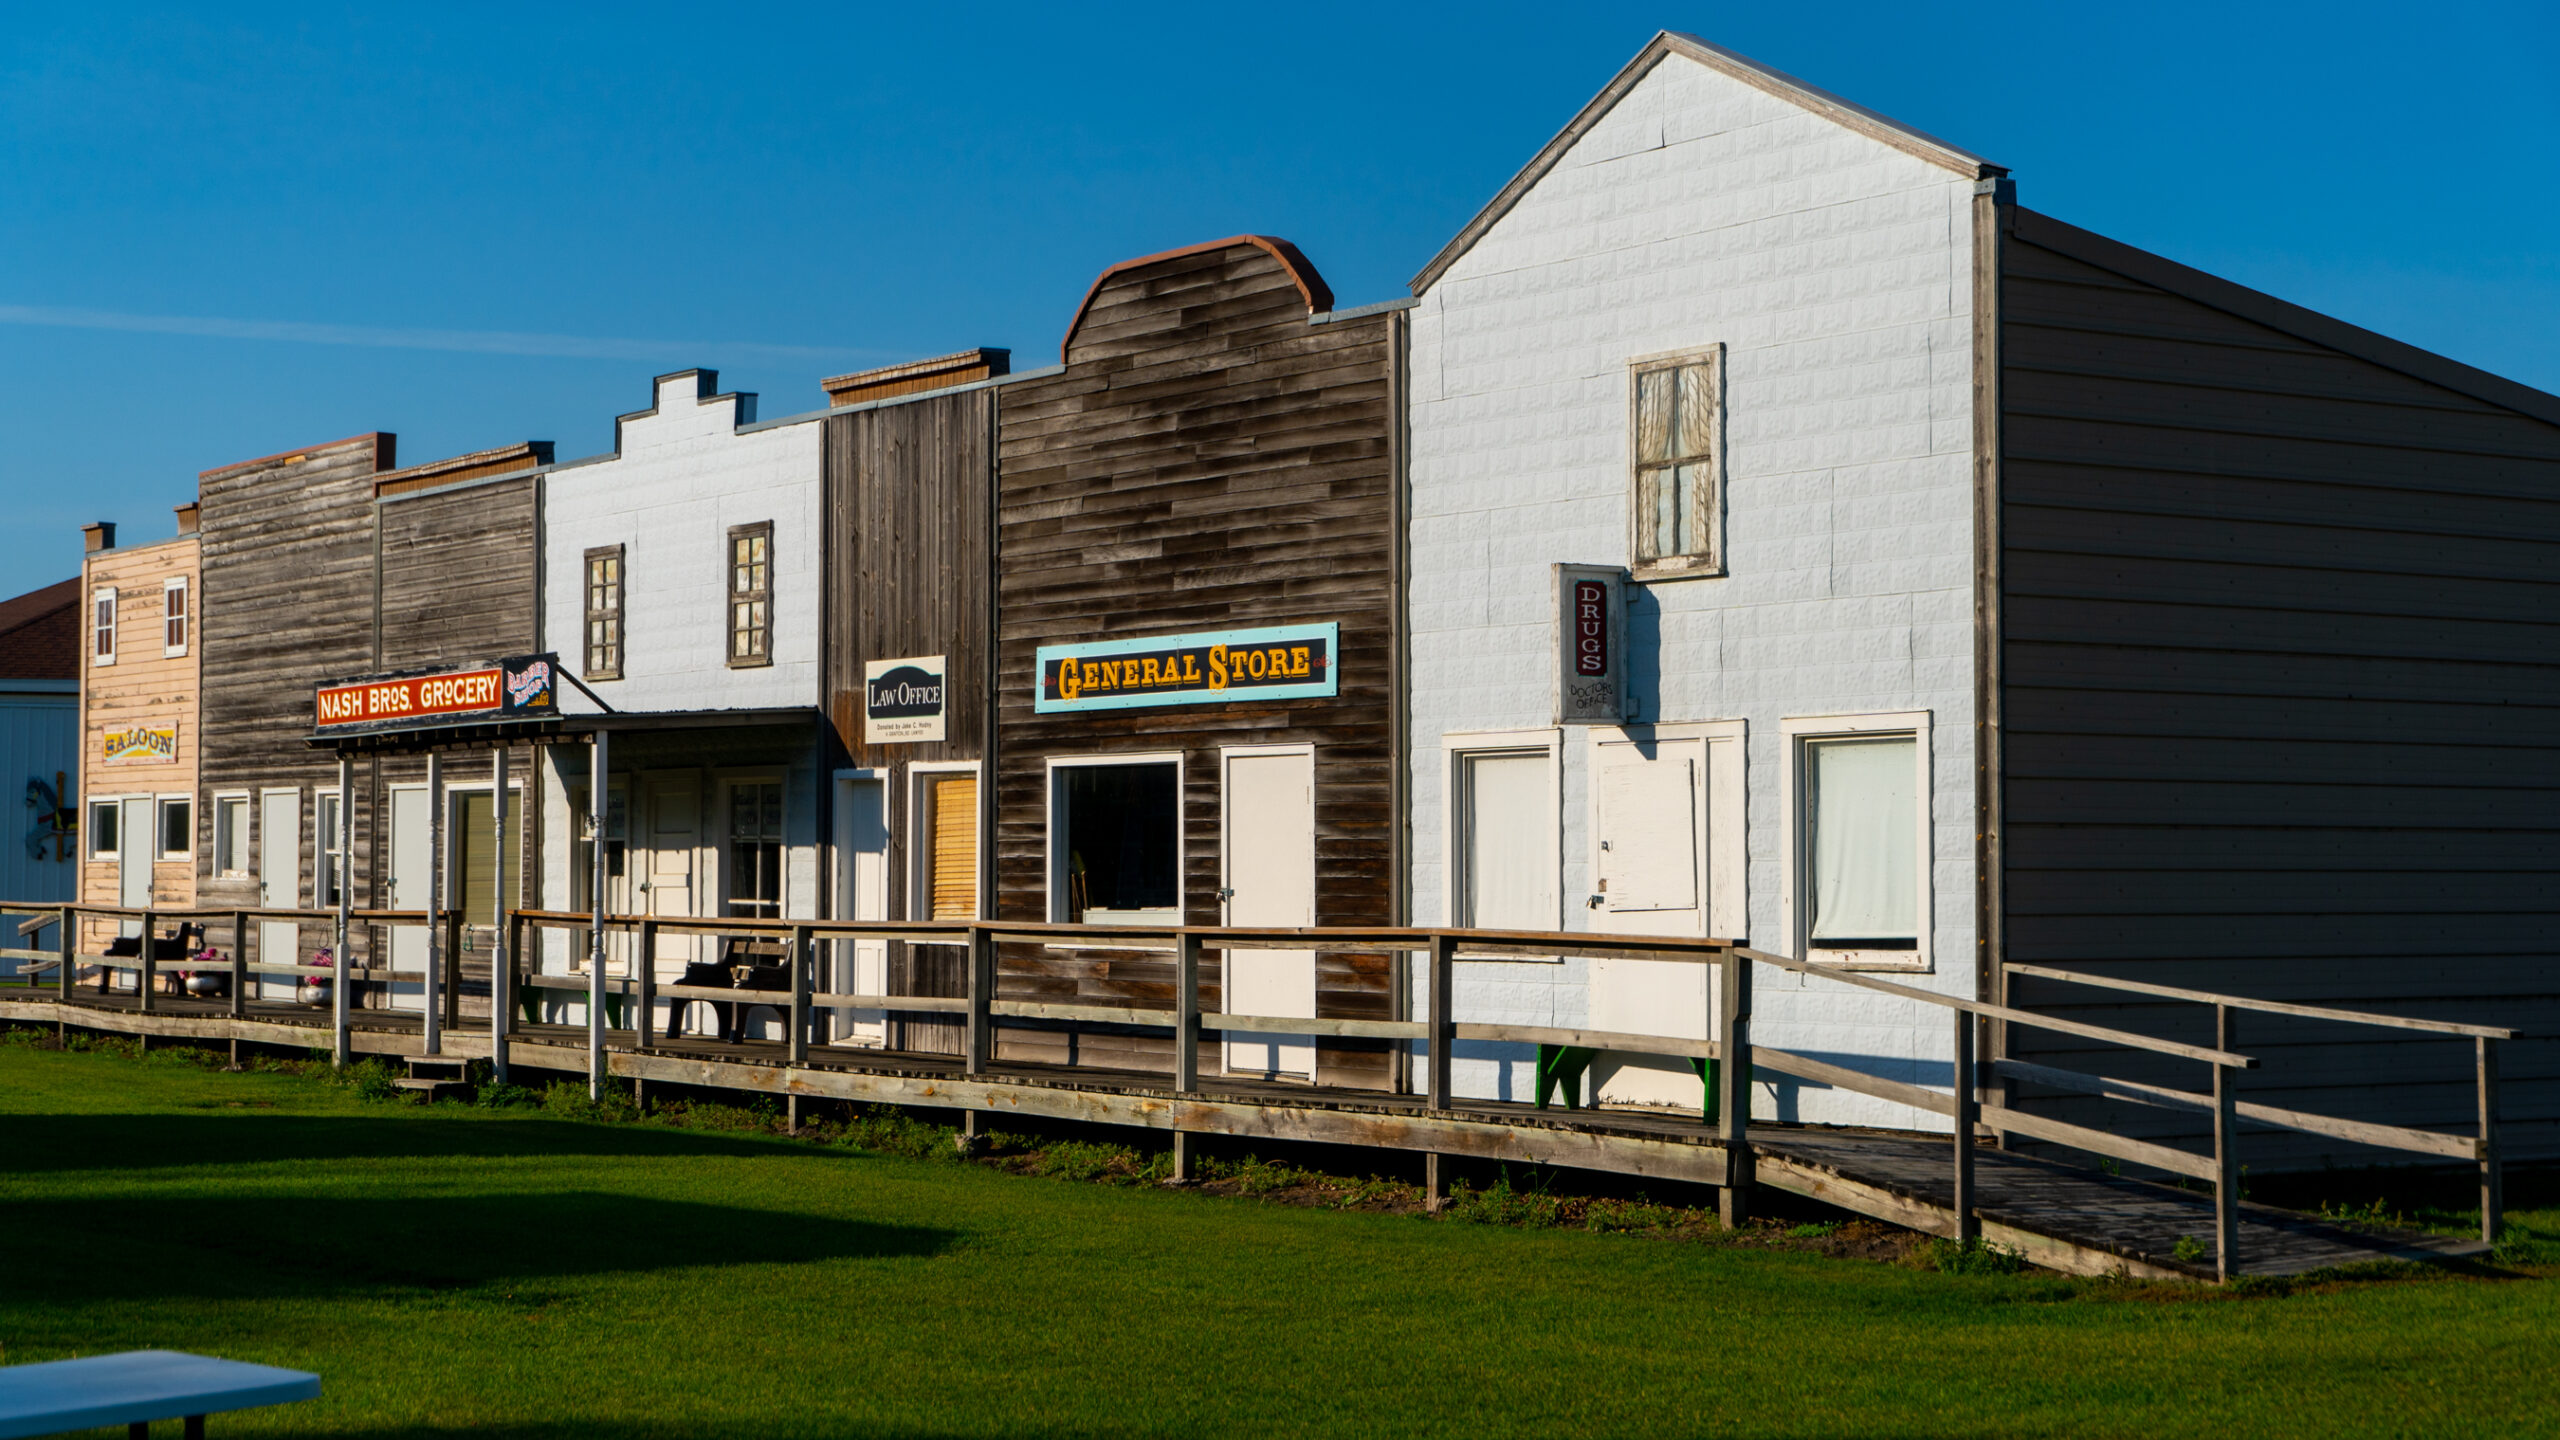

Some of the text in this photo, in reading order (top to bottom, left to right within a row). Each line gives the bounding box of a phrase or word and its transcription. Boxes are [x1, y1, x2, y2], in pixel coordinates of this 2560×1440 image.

[1581, 587, 1601, 670] DRUGS
[507, 661, 550, 694] BARBER
[1058, 643, 1311, 702] GENERAL STORE
[320, 691, 362, 719] NASH
[420, 675, 498, 708] GROCERY
[513, 679, 543, 707] SHOP
[1576, 693, 1607, 709] OFFICE
[105, 727, 174, 758] SALOON
